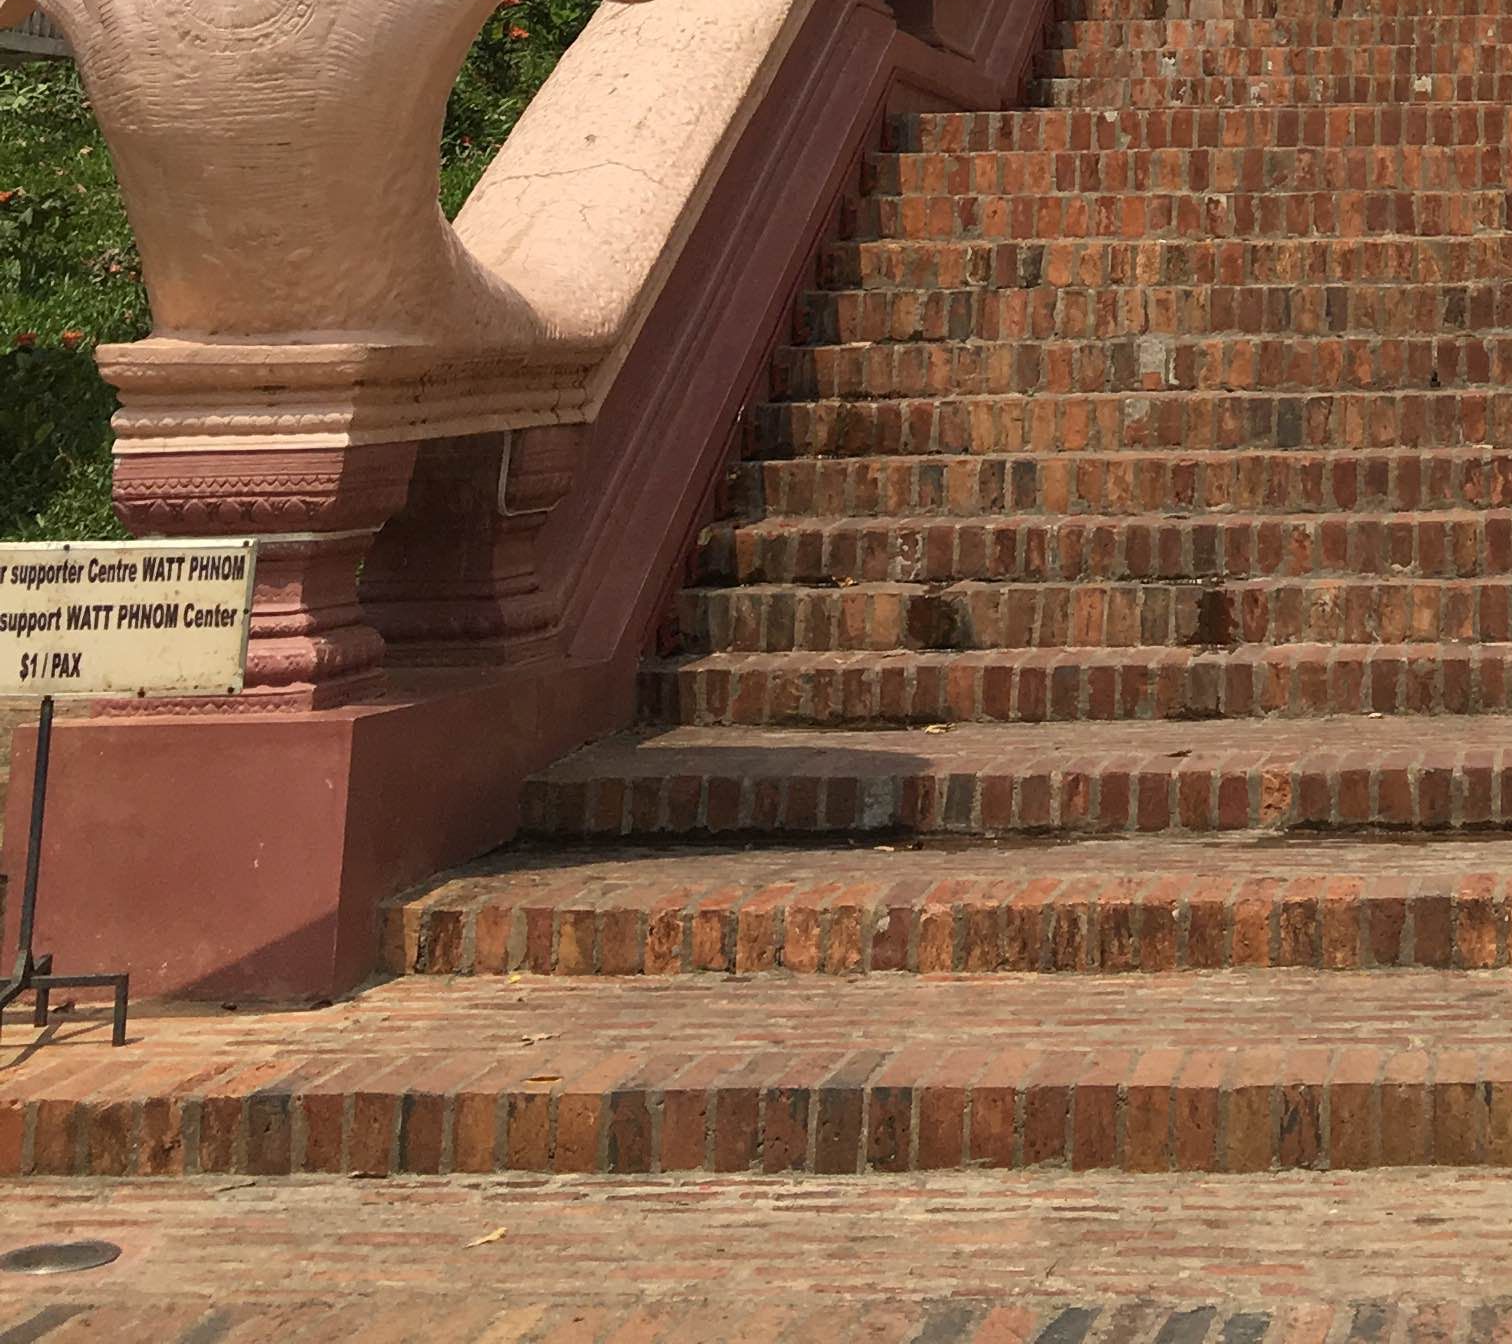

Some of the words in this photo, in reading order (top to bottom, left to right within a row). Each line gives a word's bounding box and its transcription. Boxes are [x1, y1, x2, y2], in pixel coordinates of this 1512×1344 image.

[10, 559, 84, 590] supporter
[88, 558, 137, 583] Centre
[142, 557, 185, 581] WATT
[188, 555, 245, 580] PHNOM
[0, 606, 62, 638] support
[66, 605, 114, 630] WATT
[117, 604, 178, 629] PHNOM
[183, 603, 237, 628] Center
[19, 652, 38, 682] $1
[51, 652, 82, 678] PAX
